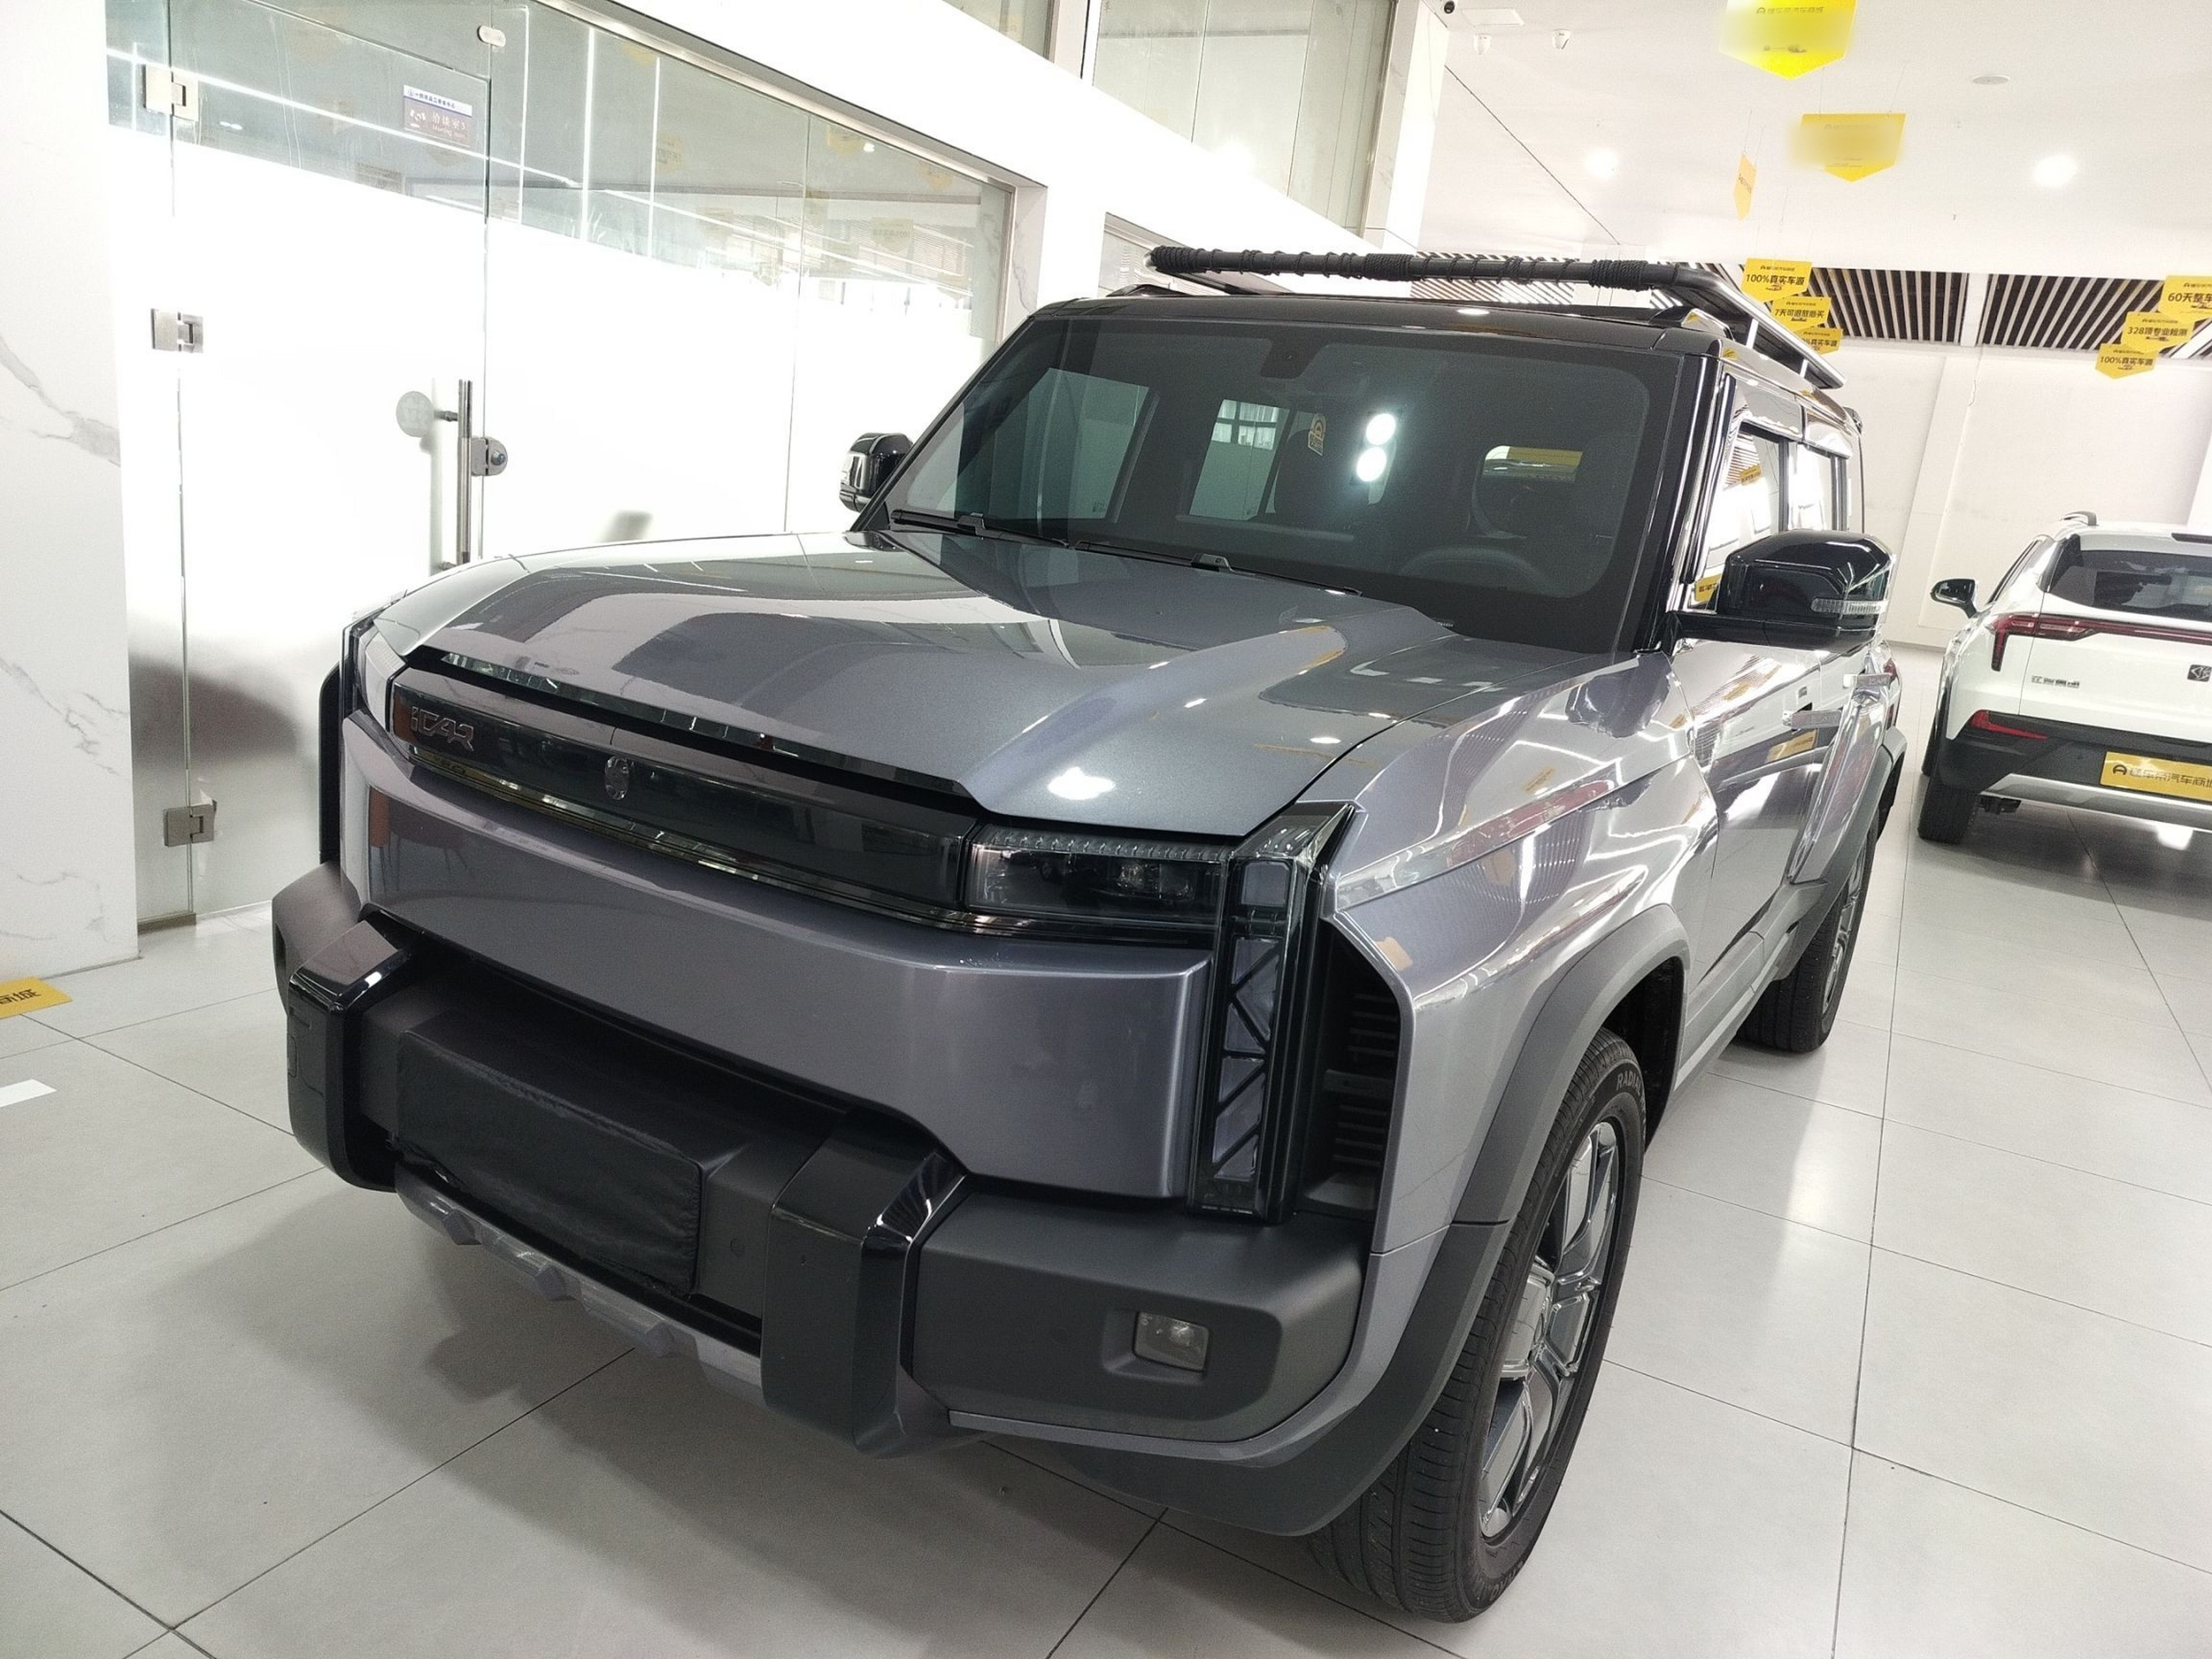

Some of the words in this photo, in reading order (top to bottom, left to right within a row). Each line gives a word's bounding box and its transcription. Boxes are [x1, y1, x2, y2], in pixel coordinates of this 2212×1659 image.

[1746, 274, 1805, 286] 100%真实车源
[1616, 1070, 1641, 1096] RADIAL
